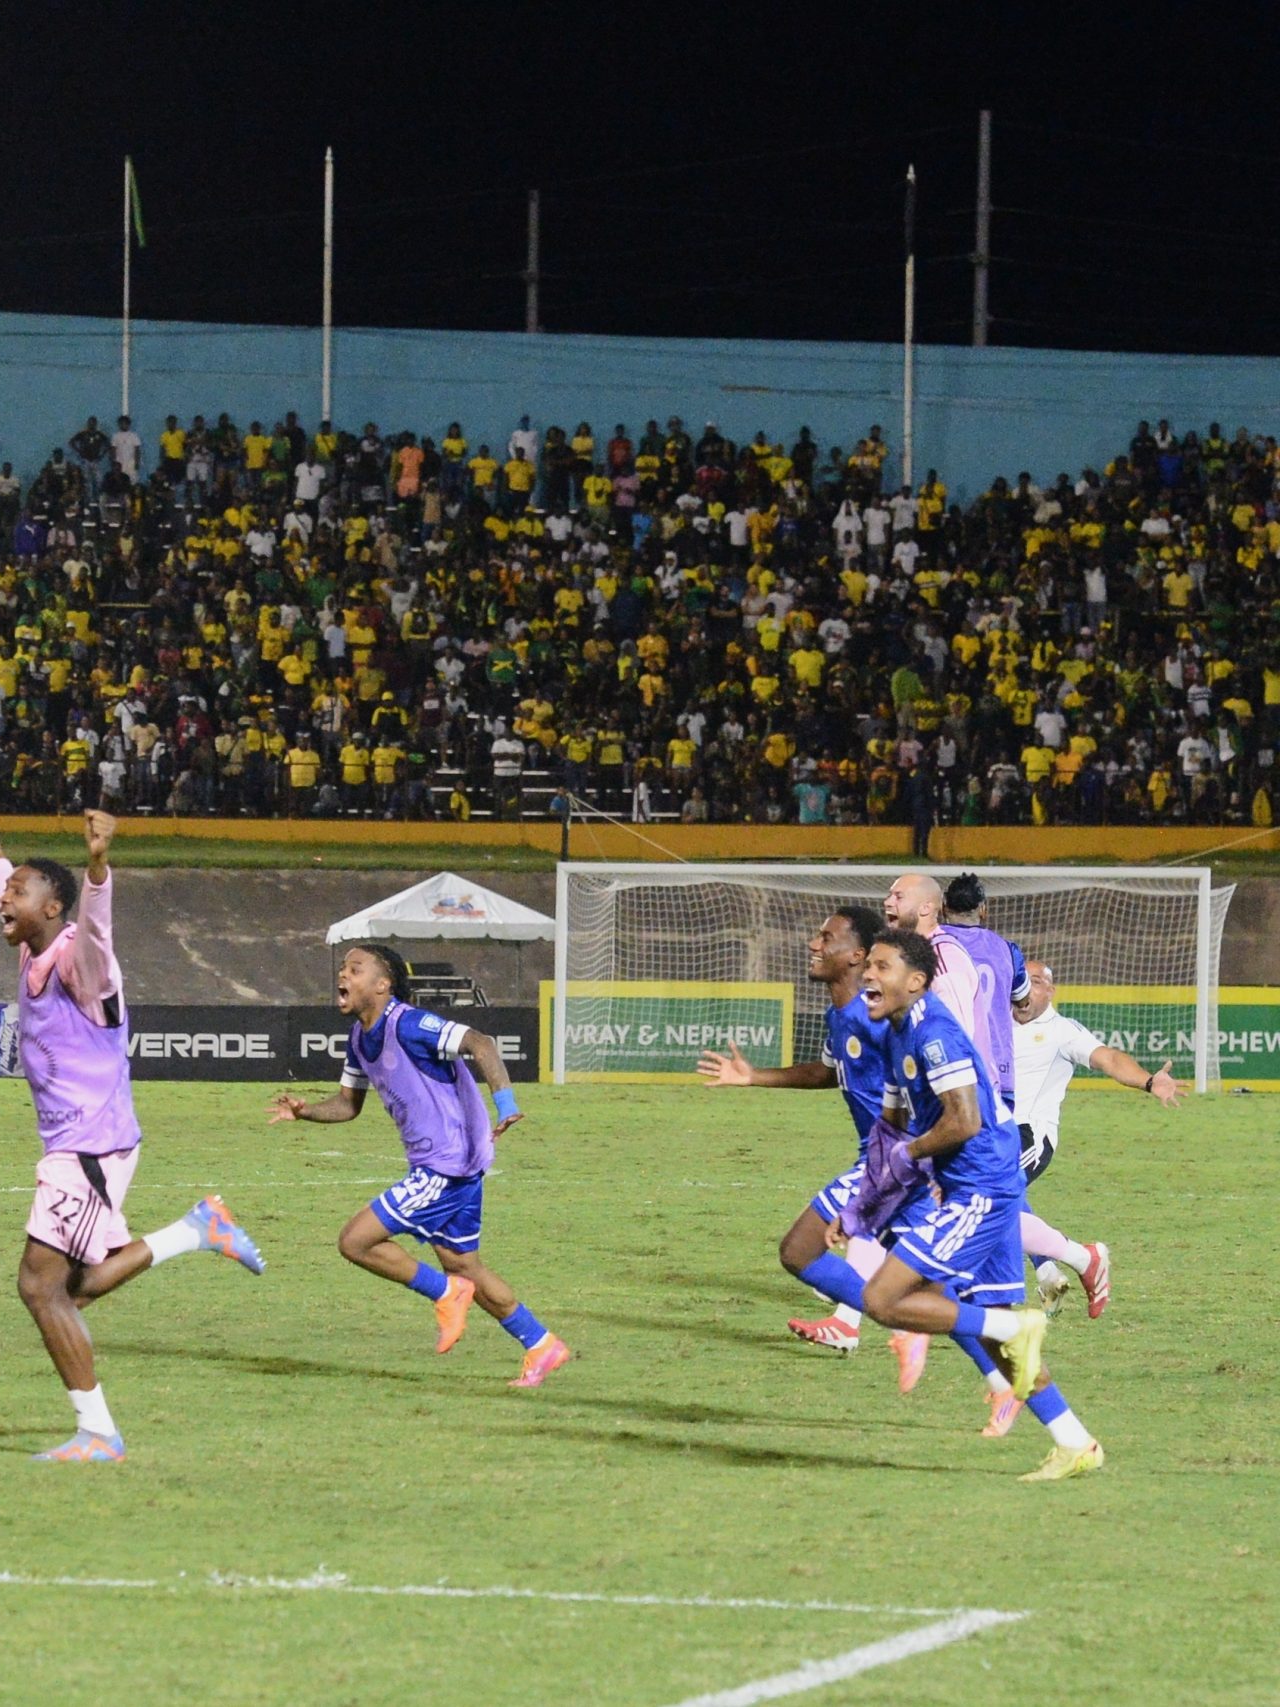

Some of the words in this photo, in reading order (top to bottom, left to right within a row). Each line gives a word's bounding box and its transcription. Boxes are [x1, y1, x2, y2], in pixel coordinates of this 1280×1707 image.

[638, 1025, 659, 1045] &
[666, 1025, 775, 1046] NEPHEW
[1148, 1031, 1169, 1052] &
[48, 1188, 84, 1224] 22
